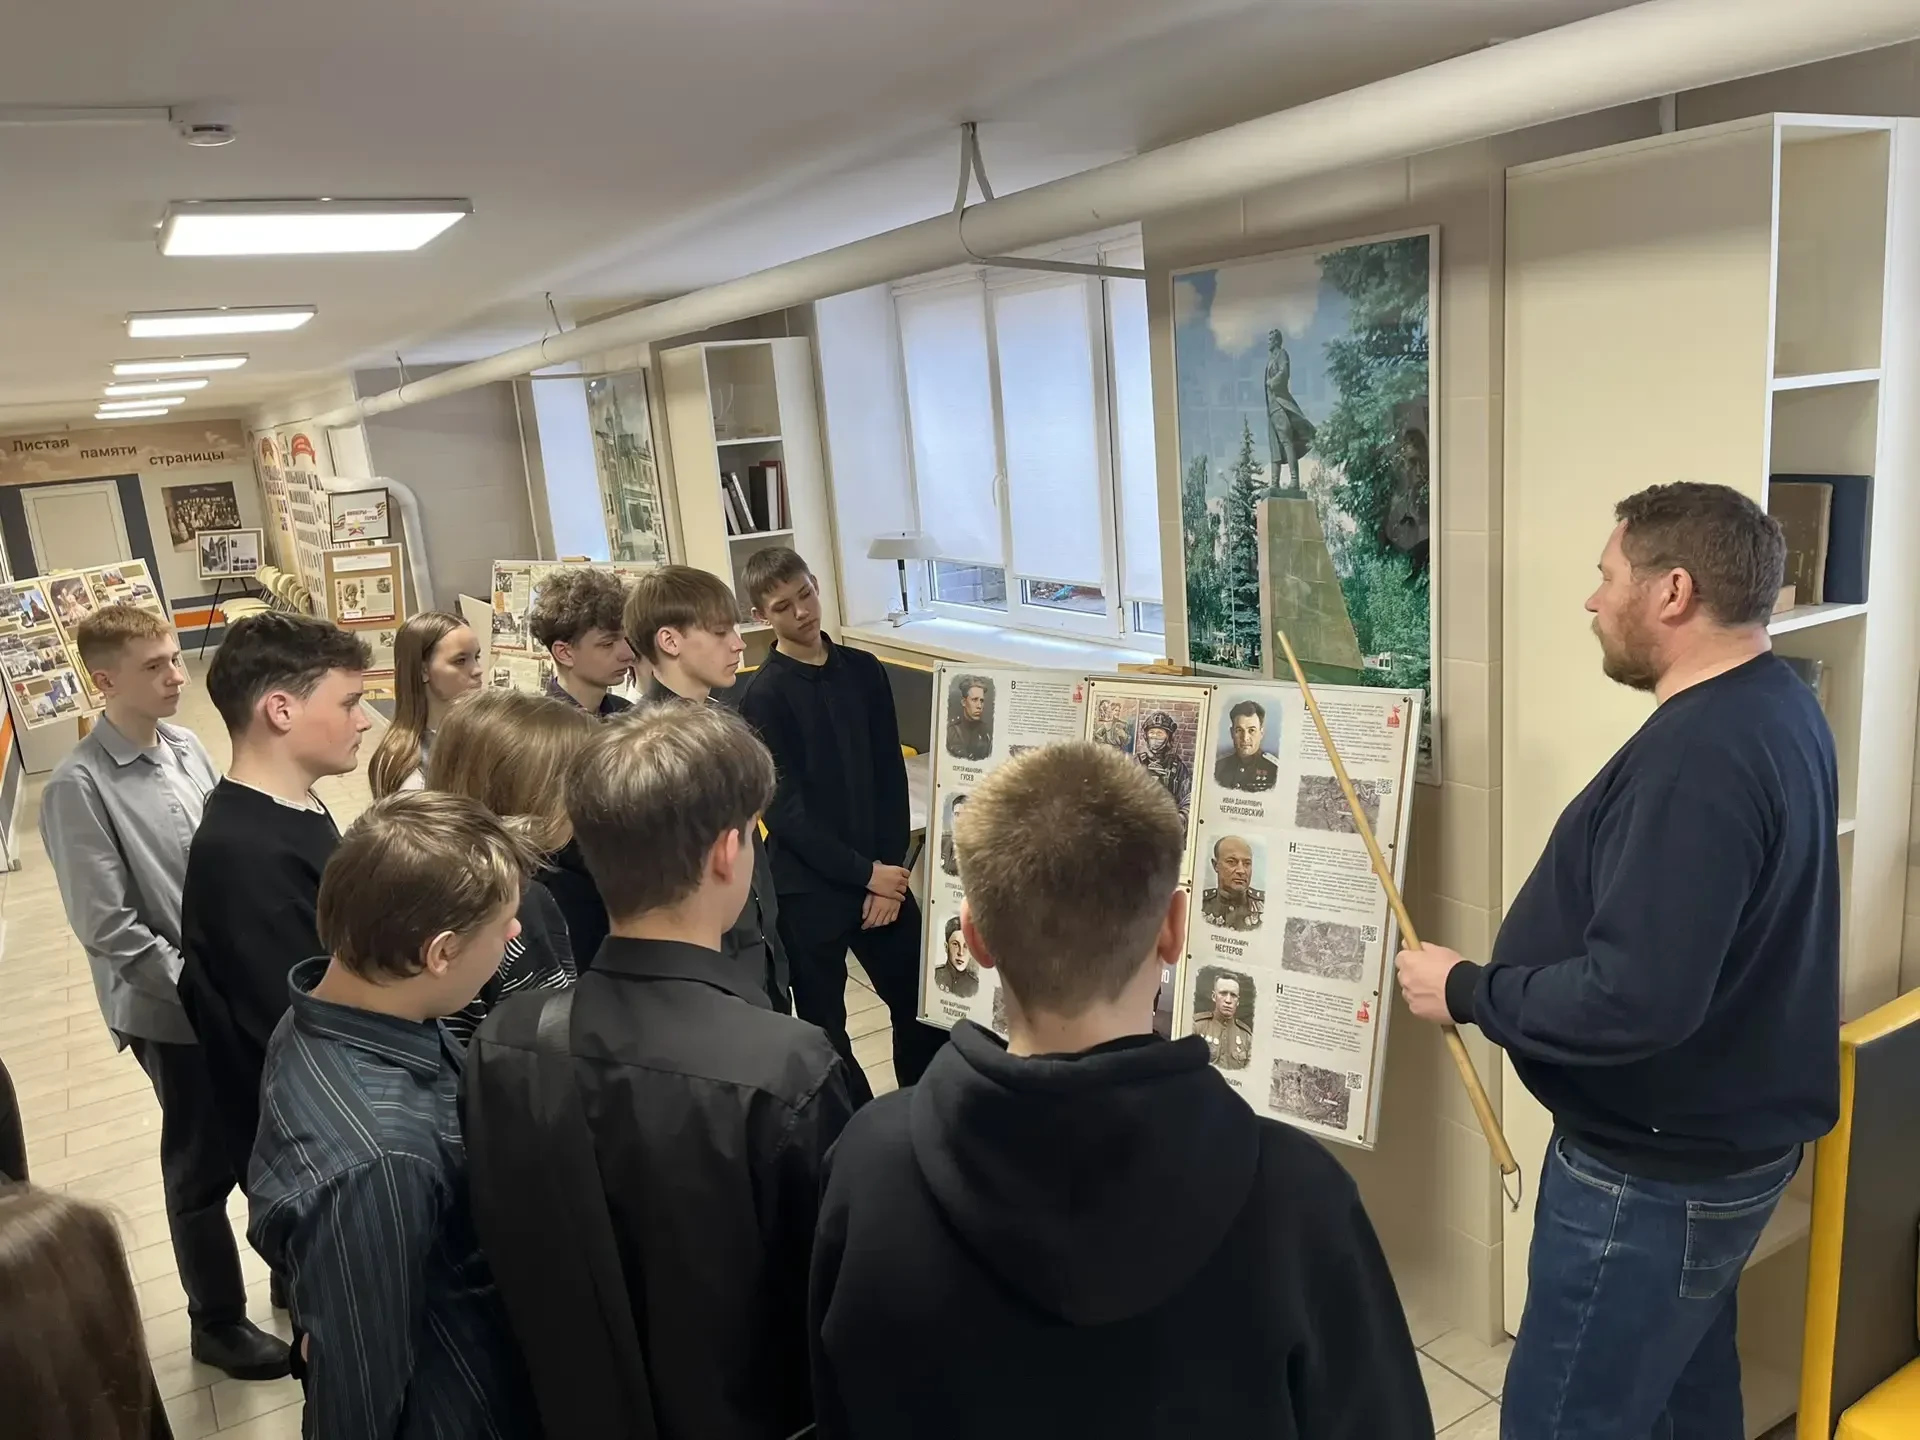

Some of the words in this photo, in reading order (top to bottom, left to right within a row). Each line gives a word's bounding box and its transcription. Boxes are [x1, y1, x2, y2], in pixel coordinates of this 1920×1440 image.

[12, 437, 70, 453] Листая
[80, 445, 137, 459] памяти
[149, 450, 224, 466] страницы
[960, 773, 975, 781] ГУСЕВ
[1235, 798, 1262, 807] ДАНИЛОВИЧ
[1220, 804, 1265, 817] ЧЕРНЯХОВСКИЙ
[1211, 934, 1227, 943] СТЕПАН
[1227, 937, 1249, 947] КУЗЬМИЧ
[1215, 943, 1243, 956] НЕСТЕРОВ
